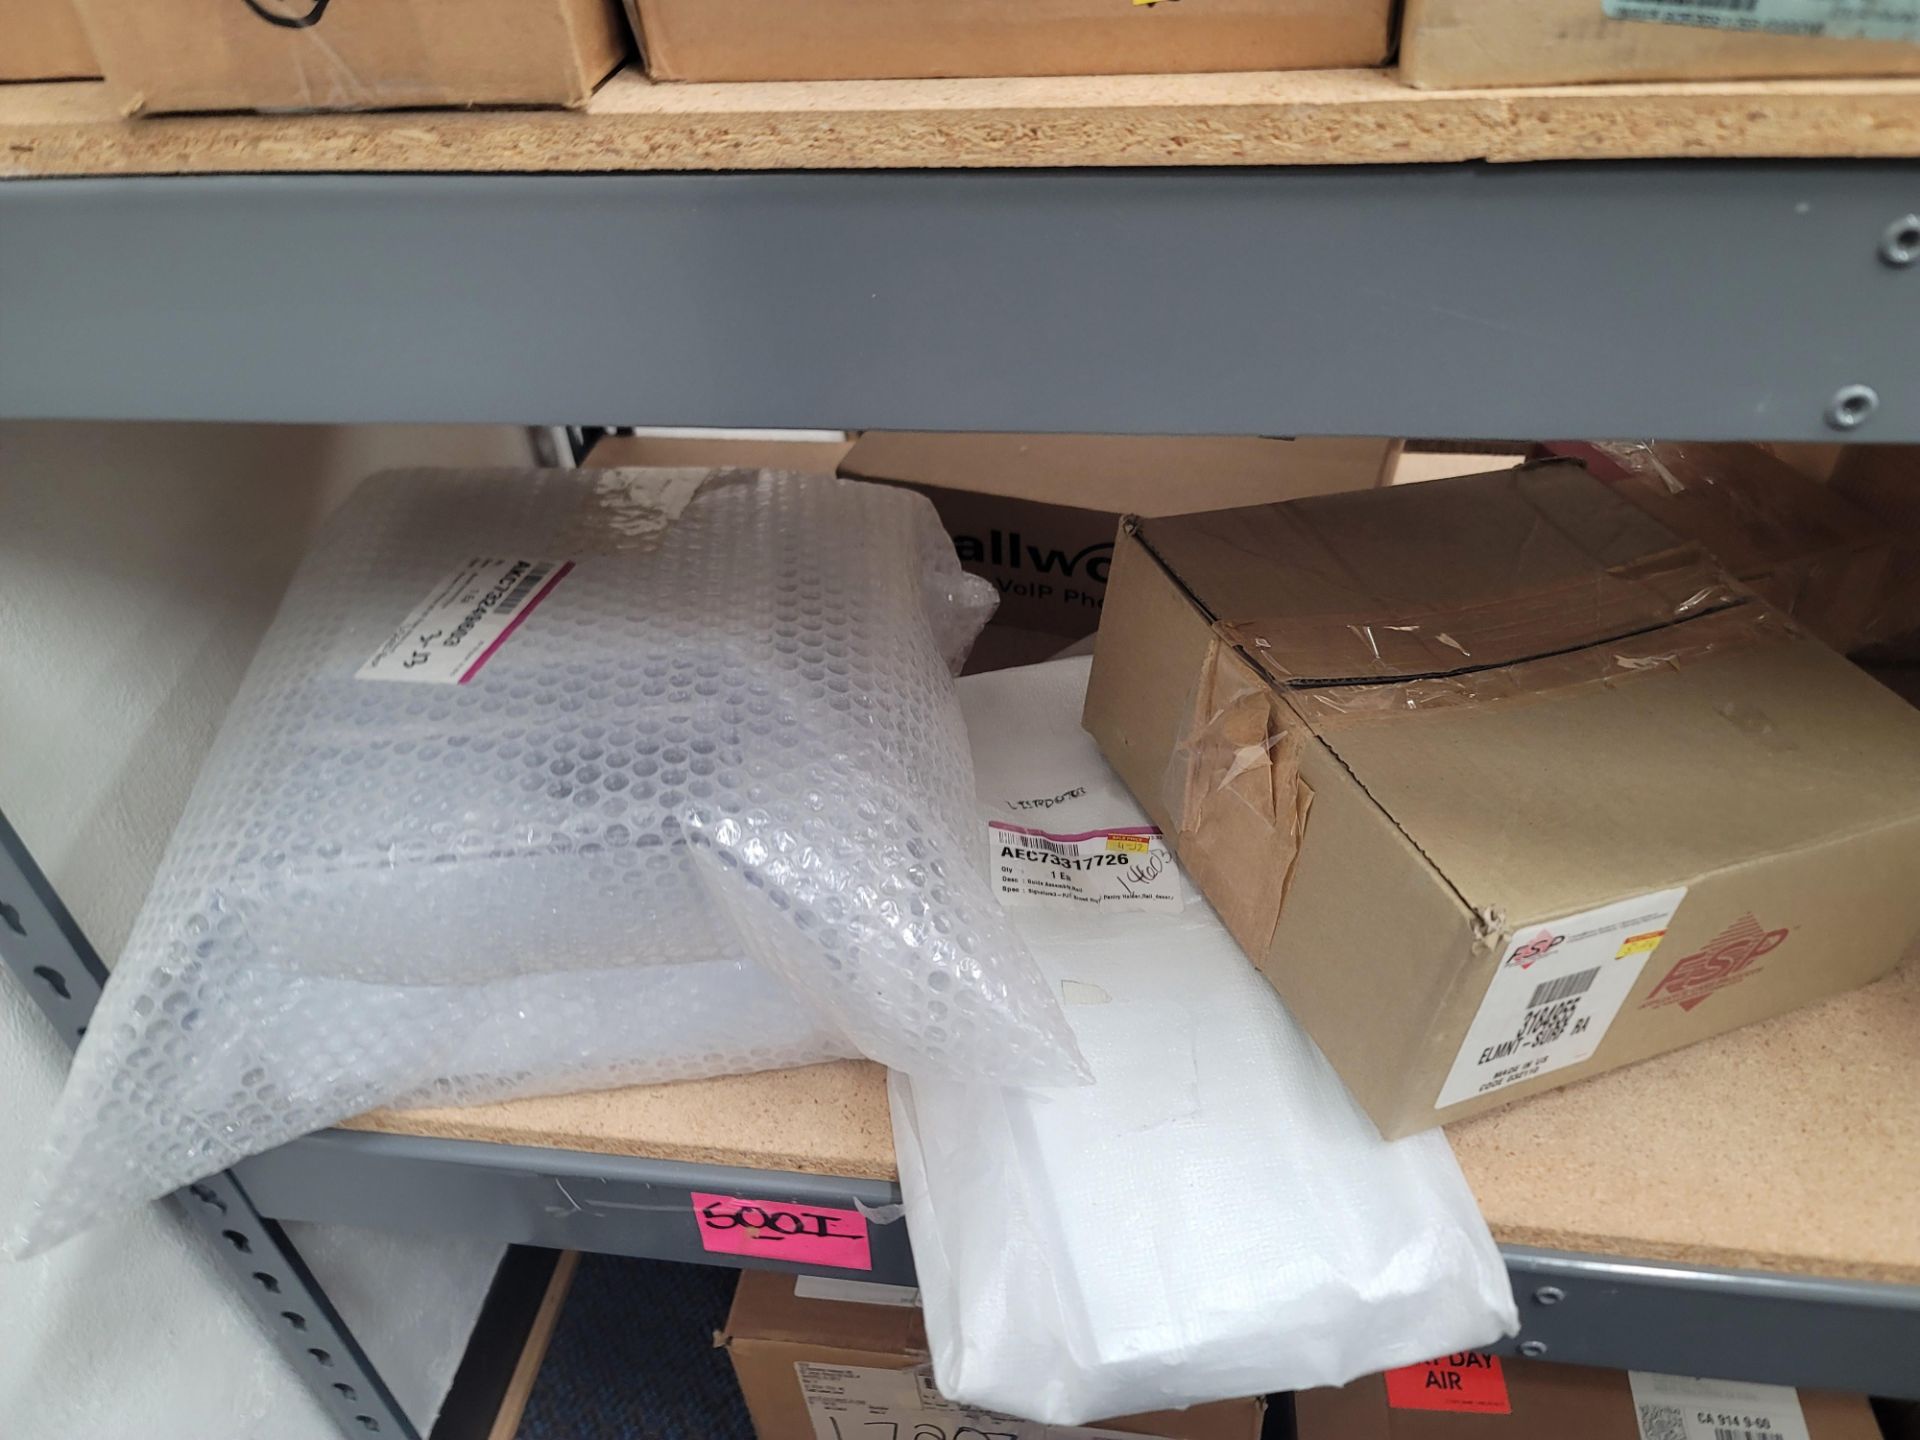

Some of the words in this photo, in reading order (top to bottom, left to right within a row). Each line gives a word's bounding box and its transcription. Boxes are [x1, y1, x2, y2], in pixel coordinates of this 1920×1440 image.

[953, 530, 1111, 584] allwo
[996, 577, 1053, 598] VoIP
[1001, 846, 1130, 872] AEC73317726
[1448, 1351, 1492, 1369] DAY
[1426, 1370, 1463, 1390] AIR
[1697, 1412, 1715, 1425] CA
